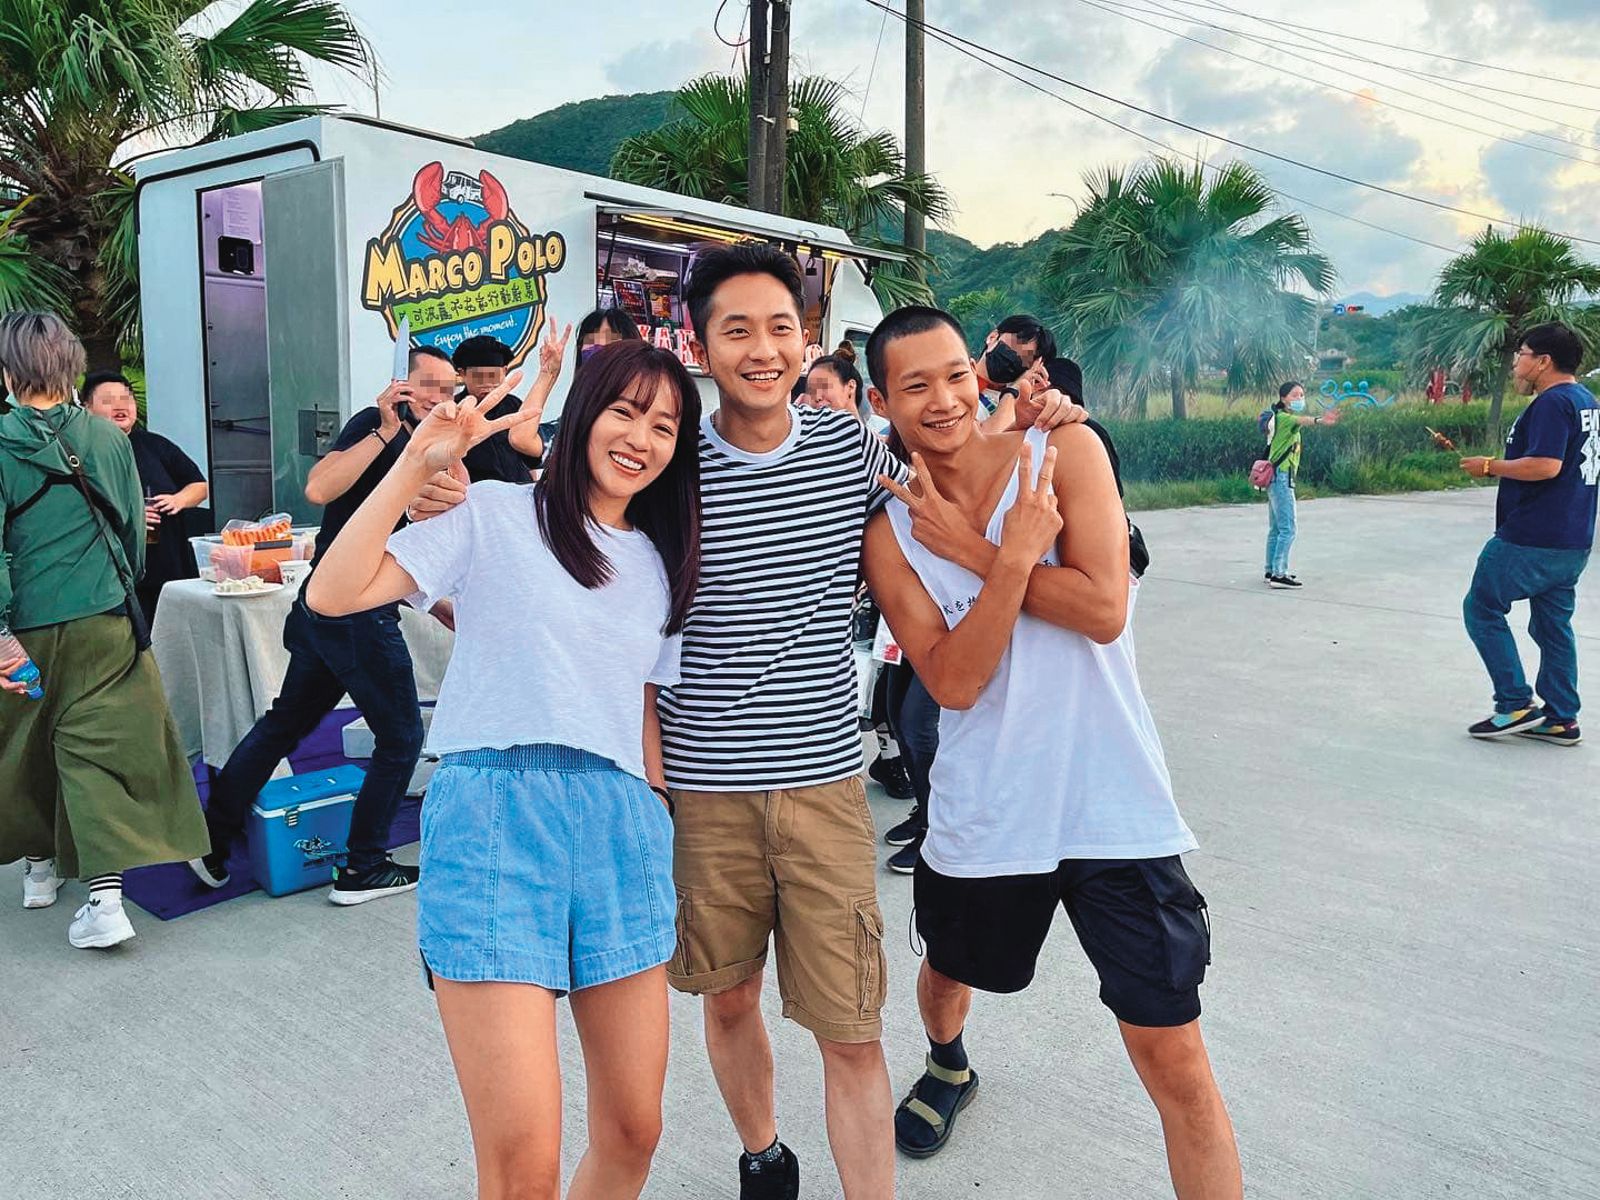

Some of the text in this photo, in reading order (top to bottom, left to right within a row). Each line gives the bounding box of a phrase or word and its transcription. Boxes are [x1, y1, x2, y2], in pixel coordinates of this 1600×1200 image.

[364, 222, 564, 306] MARCO POLO
[433, 332, 463, 350] Enjoy
